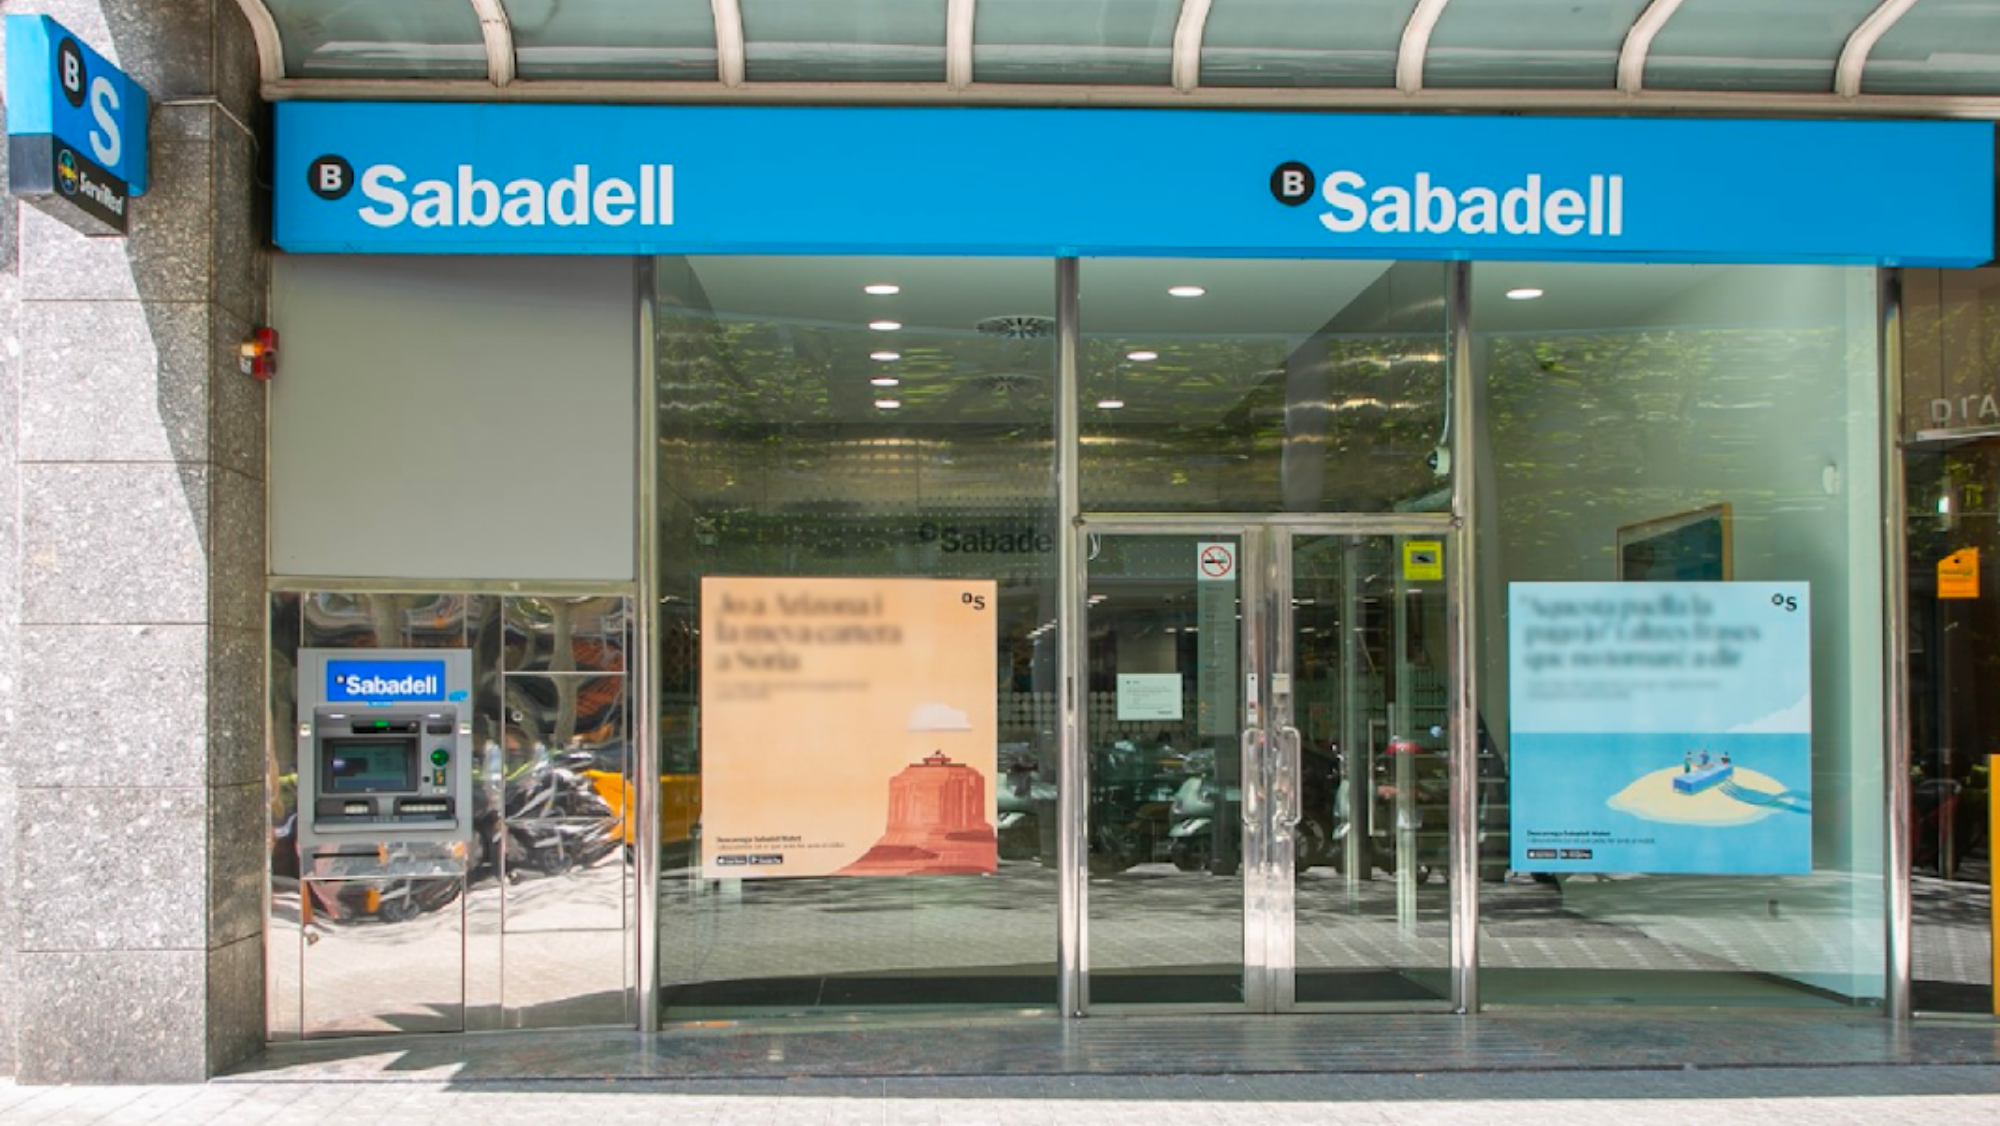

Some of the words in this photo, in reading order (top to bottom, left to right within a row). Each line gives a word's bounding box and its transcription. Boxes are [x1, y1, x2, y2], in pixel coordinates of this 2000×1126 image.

[63, 51, 80, 92] B
[89, 76, 121, 167] S
[319, 164, 343, 191] B
[358, 164, 675, 228] Sabadell
[1282, 170, 1305, 197] B
[1319, 170, 1623, 236] Sabadell
[346, 675, 437, 695] Sabadell
